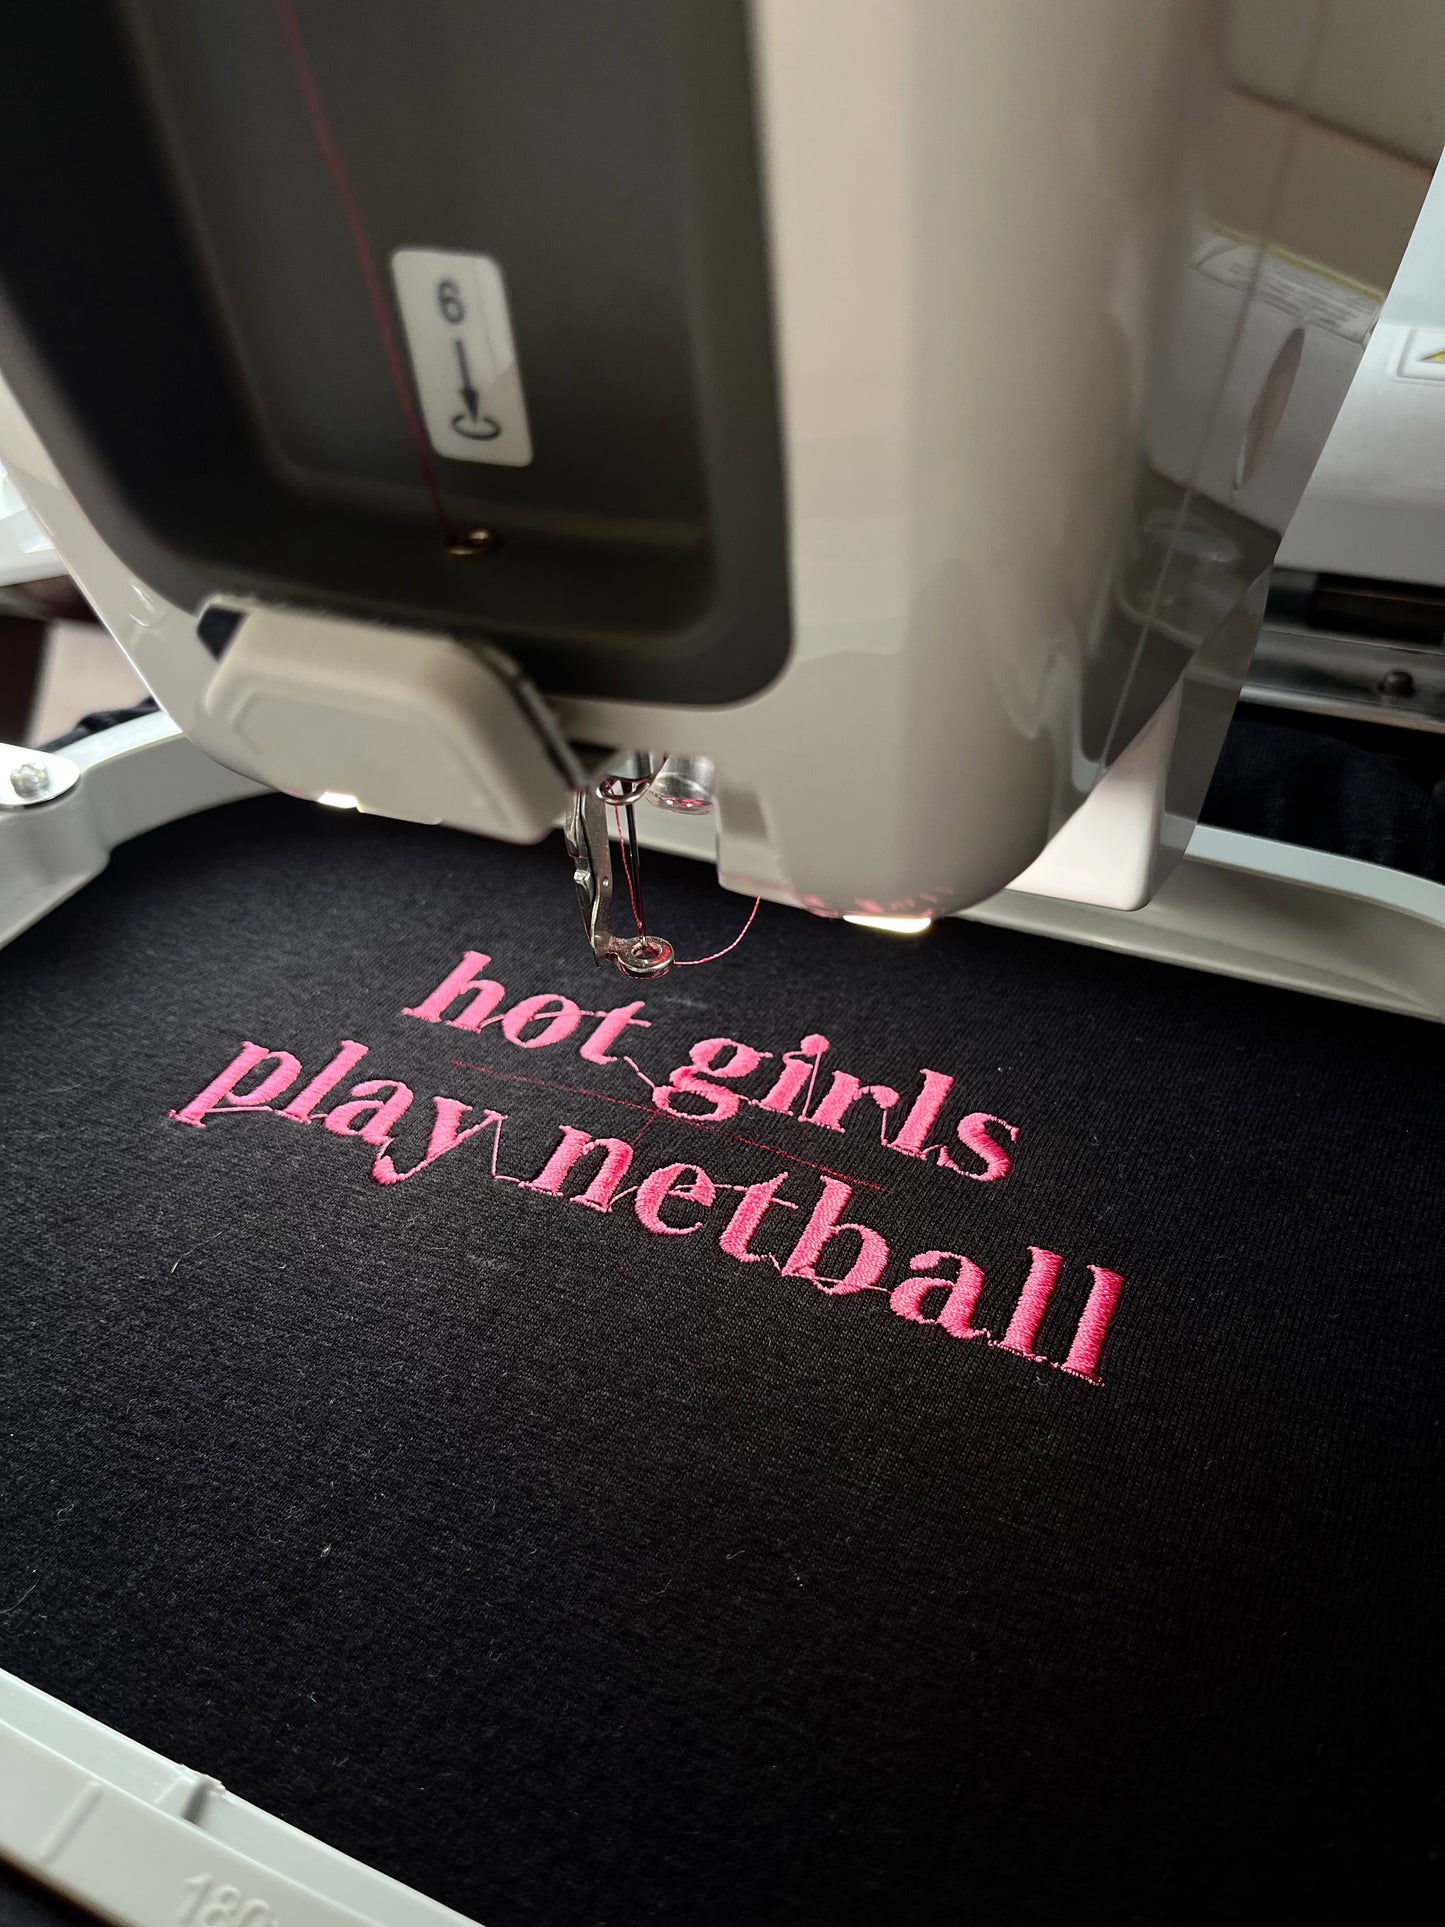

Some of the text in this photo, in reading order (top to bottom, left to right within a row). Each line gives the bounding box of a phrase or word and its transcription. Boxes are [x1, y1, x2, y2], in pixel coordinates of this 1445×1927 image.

[436, 277, 465, 325] 6
[404, 951, 1021, 1184] hot girls
[168, 1041, 1126, 1386] play netball
[173, 1872, 279, 1927] 180
